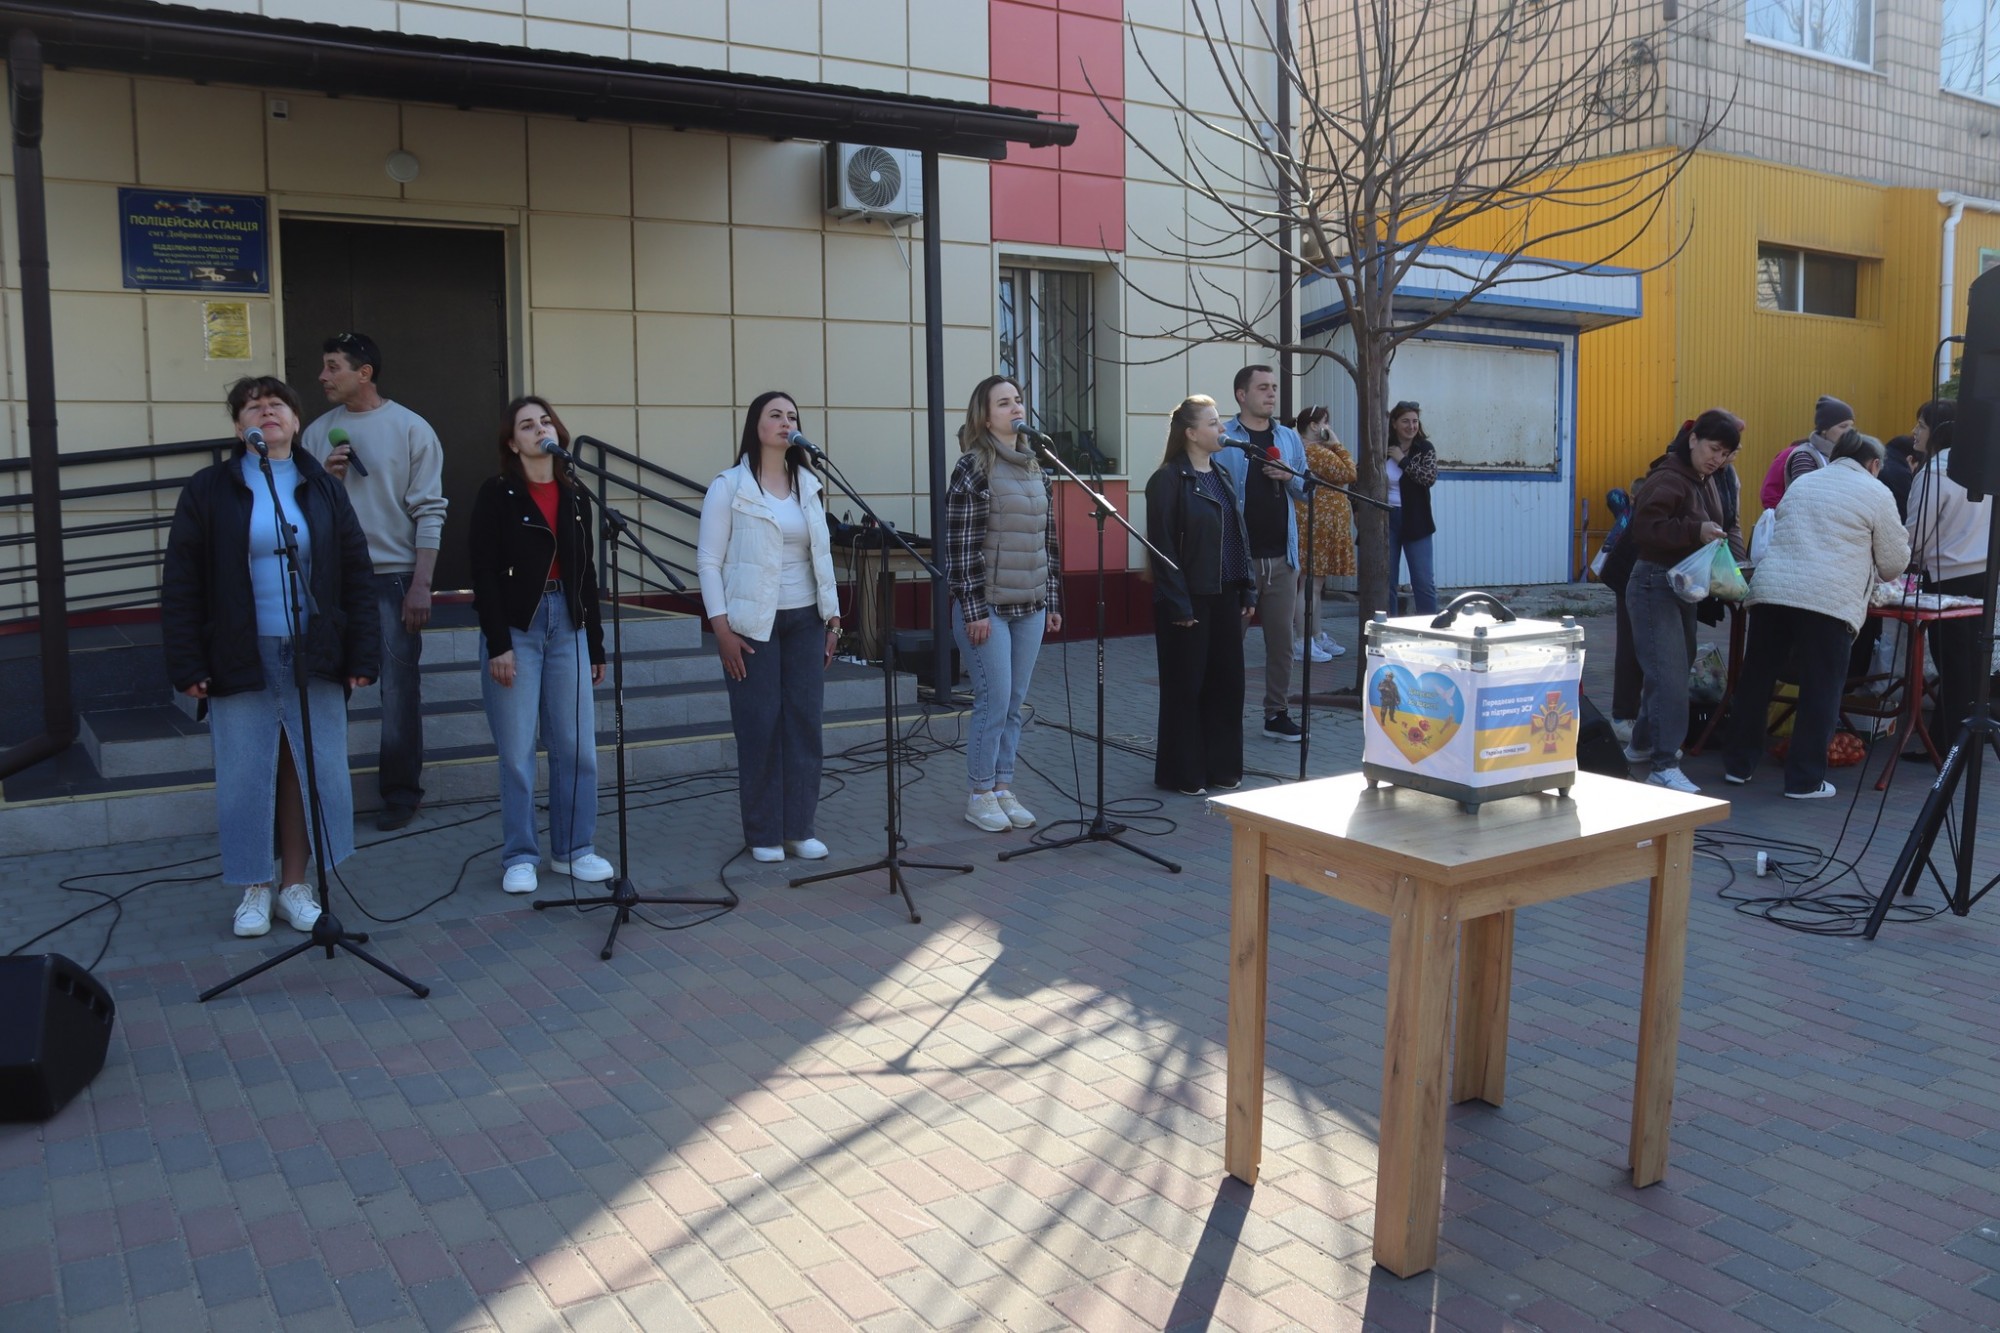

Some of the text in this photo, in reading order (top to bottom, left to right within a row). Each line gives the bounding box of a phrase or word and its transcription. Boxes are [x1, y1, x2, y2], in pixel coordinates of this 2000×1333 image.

[129, 215, 259, 232] ПОЛІЦЕЙСЬКА СТАНЦІЯ
[1482, 697, 1515, 708] Передаємо
[1521, 704, 1533, 713] ЗСУ
